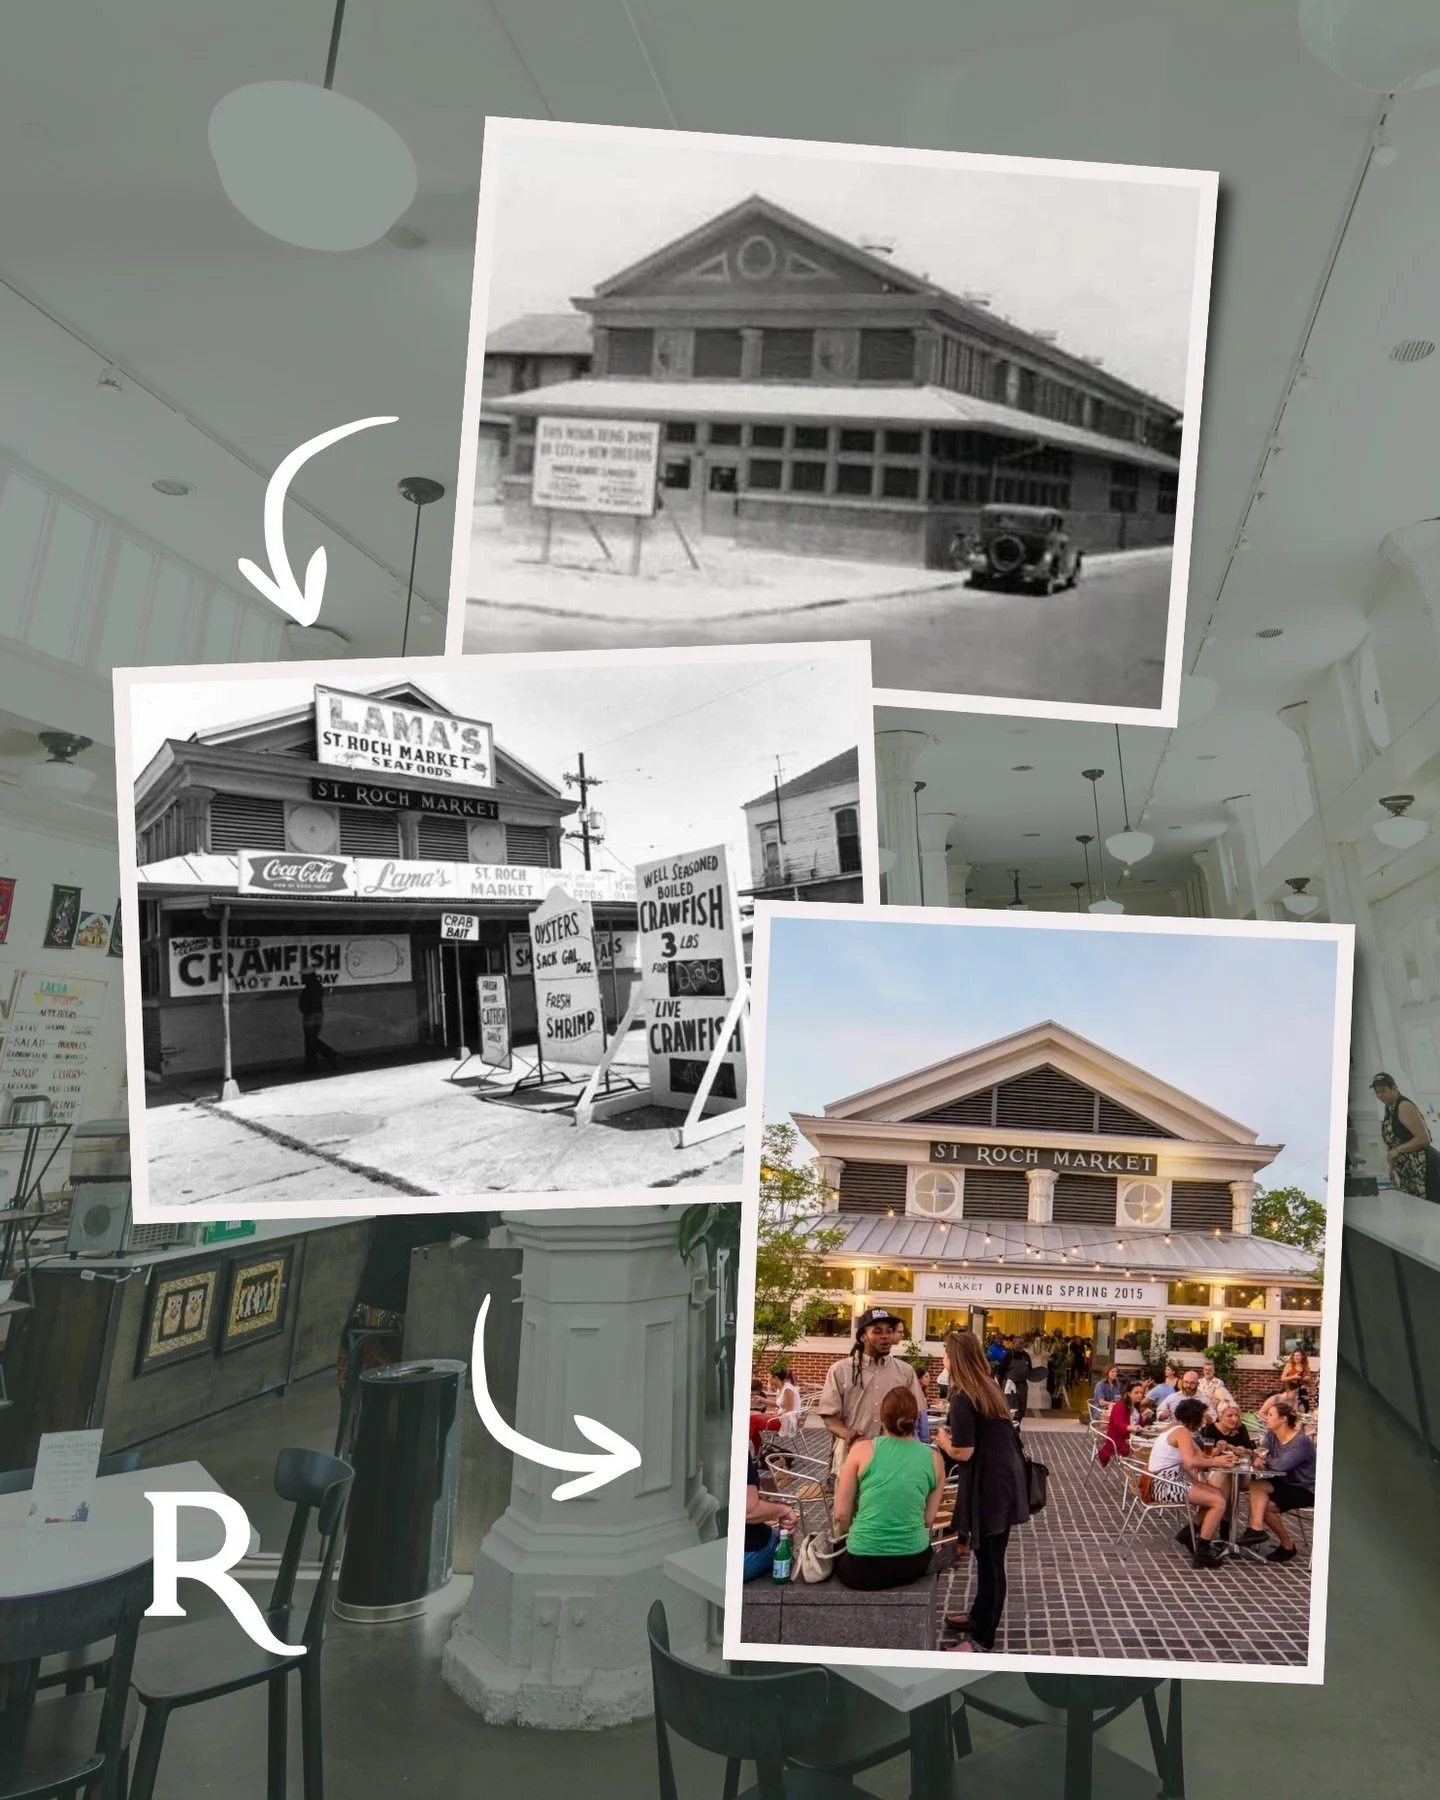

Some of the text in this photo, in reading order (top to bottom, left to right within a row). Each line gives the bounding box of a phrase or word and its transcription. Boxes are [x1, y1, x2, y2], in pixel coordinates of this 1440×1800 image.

[329, 697, 482, 756] LAMA'S
[323, 731, 471, 770] ST. ROCH MARKET
[317, 782, 496, 817] ST. ROCH MARKET
[263, 859, 334, 883] Coca-Cola
[363, 861, 452, 895] Lama's
[474, 866, 526, 882] ST. ROCH
[643, 864, 669, 889] WELL
[671, 855, 718, 881] SEASONED
[470, 882, 534, 897] MARKET
[657, 881, 694, 900] BOILED
[640, 884, 724, 934] CRAWFISH
[444, 915, 474, 928] CRAB
[534, 912, 580, 945] OYSTERS
[446, 926, 470, 939] BAIT
[212, 937, 261, 950] BILED
[661, 931, 699, 958] 3 LBS
[178, 944, 342, 988] CRAWFISH
[536, 949, 558, 970] SACK
[652, 962, 668, 974] FOR
[234, 976, 272, 991] HOT
[279, 974, 306, 988] AL
[546, 992, 572, 1010] FRESH
[655, 1000, 682, 1018] LIVE
[481, 1007, 506, 1026] CATFISH
[546, 1010, 596, 1039] SHRIMP
[11, 1067, 39, 1079] SOUP
[52, 1068, 83, 1080] CURRY
[934, 1143, 1153, 1173] ST ROCH MARKET
[938, 1281, 983, 1292] MARKET
[995, 1281, 1143, 1300] OPENING SPRING 2015
